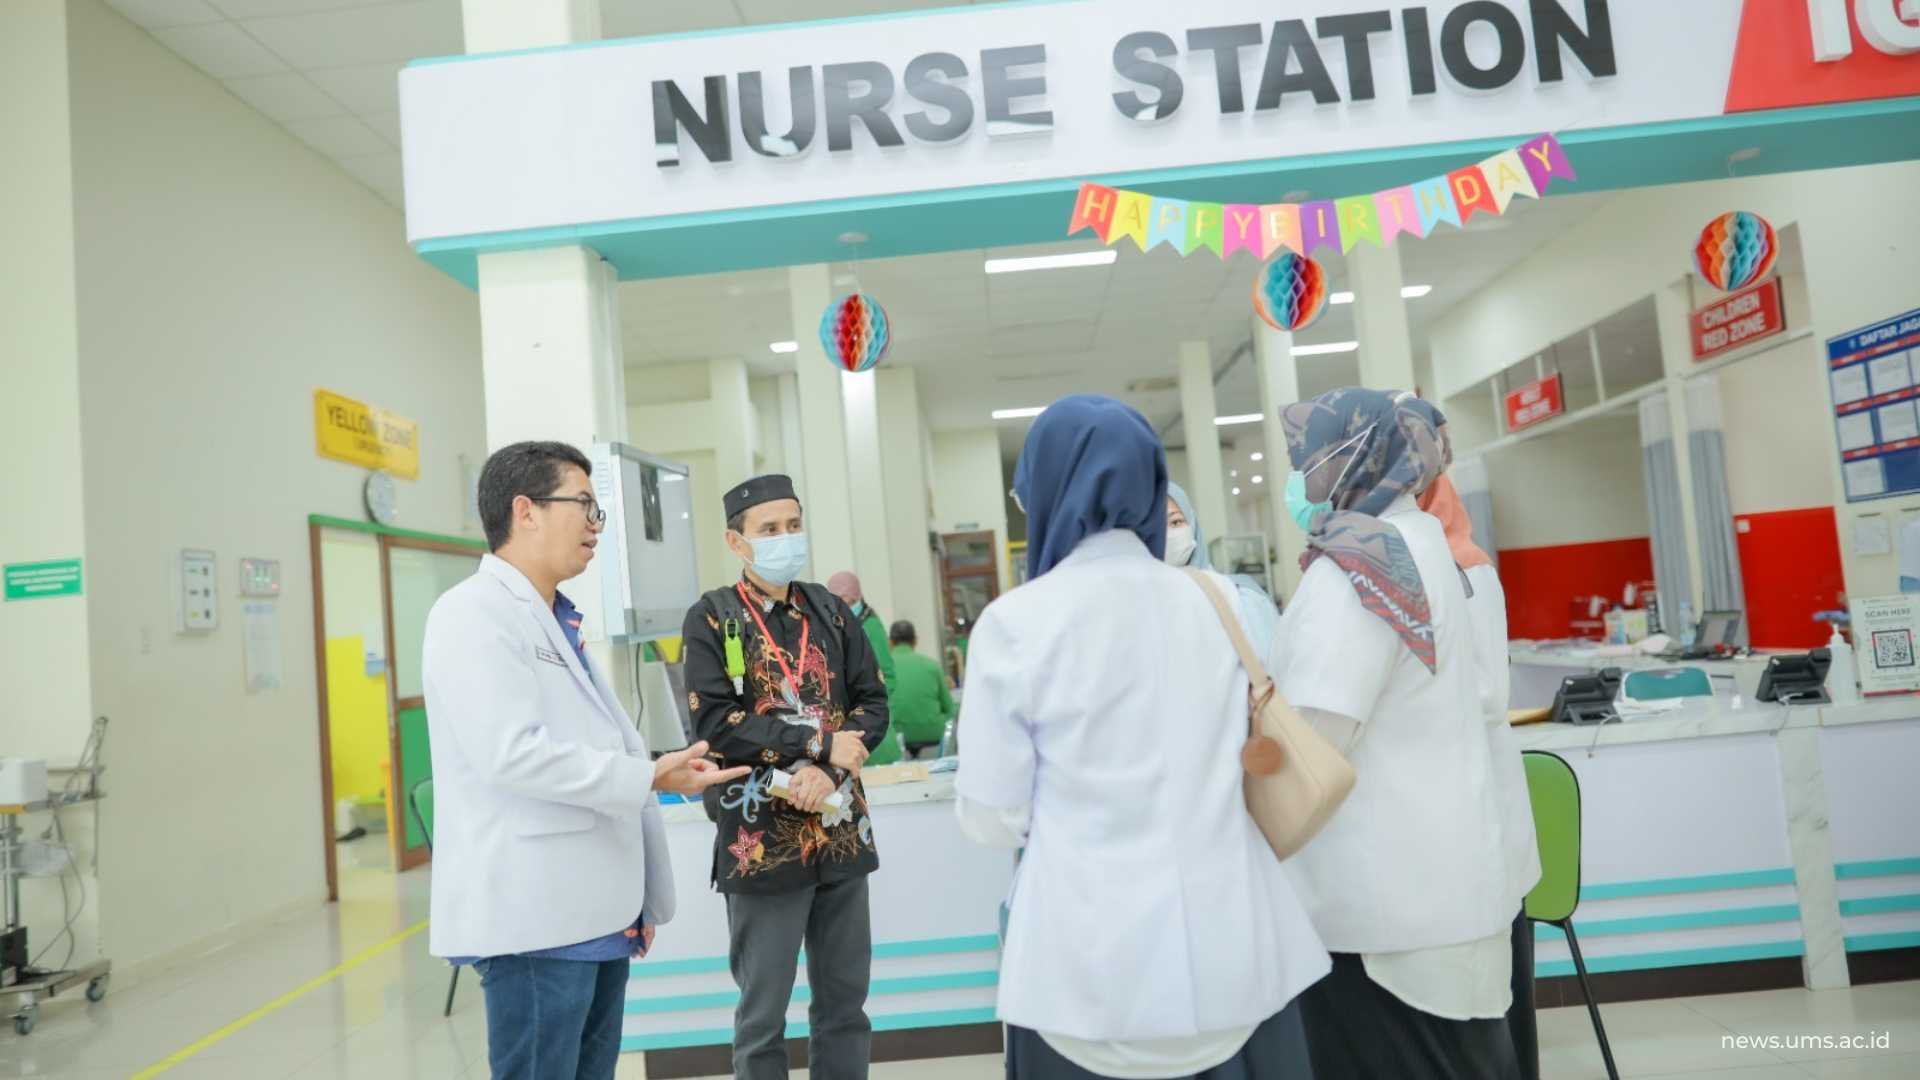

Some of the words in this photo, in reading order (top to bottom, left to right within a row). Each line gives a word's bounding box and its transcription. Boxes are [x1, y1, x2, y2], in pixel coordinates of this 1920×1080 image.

[651, 44, 1054, 168] NURSE
[1112, 0, 1617, 122] STATION
[1702, 290, 1760, 330] CHILDREN
[1703, 327, 1728, 352] RED
[1729, 310, 1766, 341] ZONE
[1859, 323, 1897, 347] DAFTAR
[326, 402, 377, 437] YELLOW
[383, 421, 412, 450] ZONE
